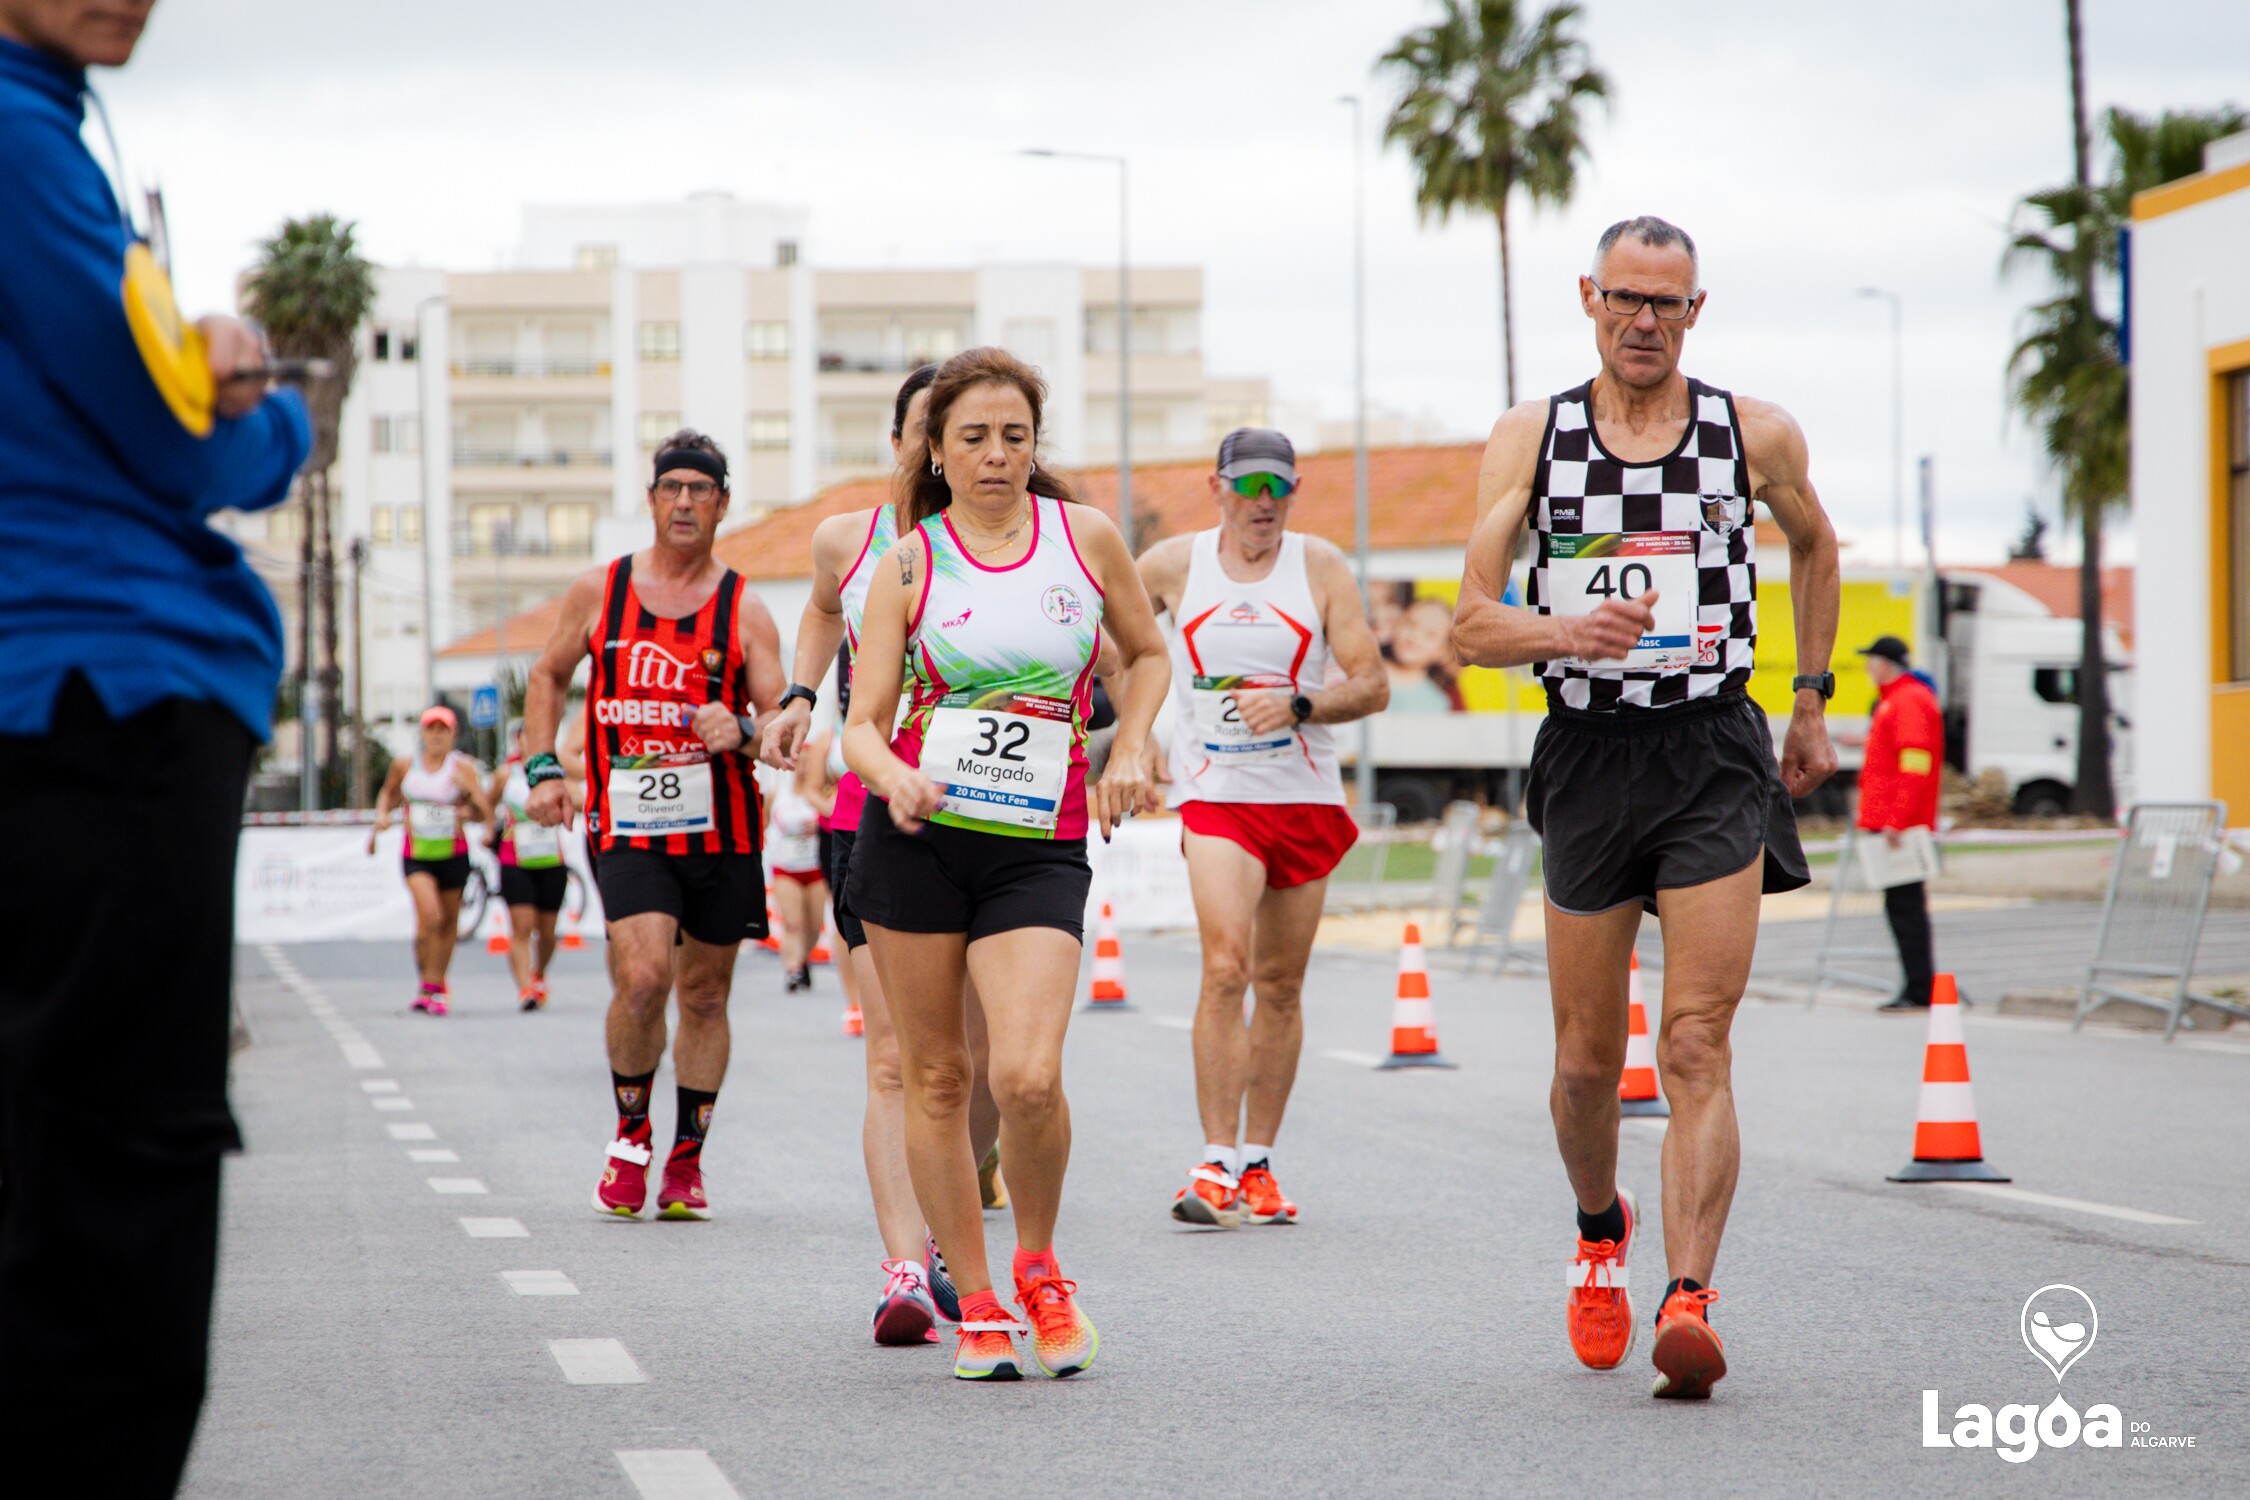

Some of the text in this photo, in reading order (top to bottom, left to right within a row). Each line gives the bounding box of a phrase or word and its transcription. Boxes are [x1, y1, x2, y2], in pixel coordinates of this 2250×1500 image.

[1585, 562, 1653, 601] 40
[971, 716, 1031, 762] 32
[956, 757, 1034, 783] Morgado
[638, 772, 681, 801] 28
[955, 786, 1029, 807] 20 Km Vet Fem
[638, 802, 685, 815] Oliveira
